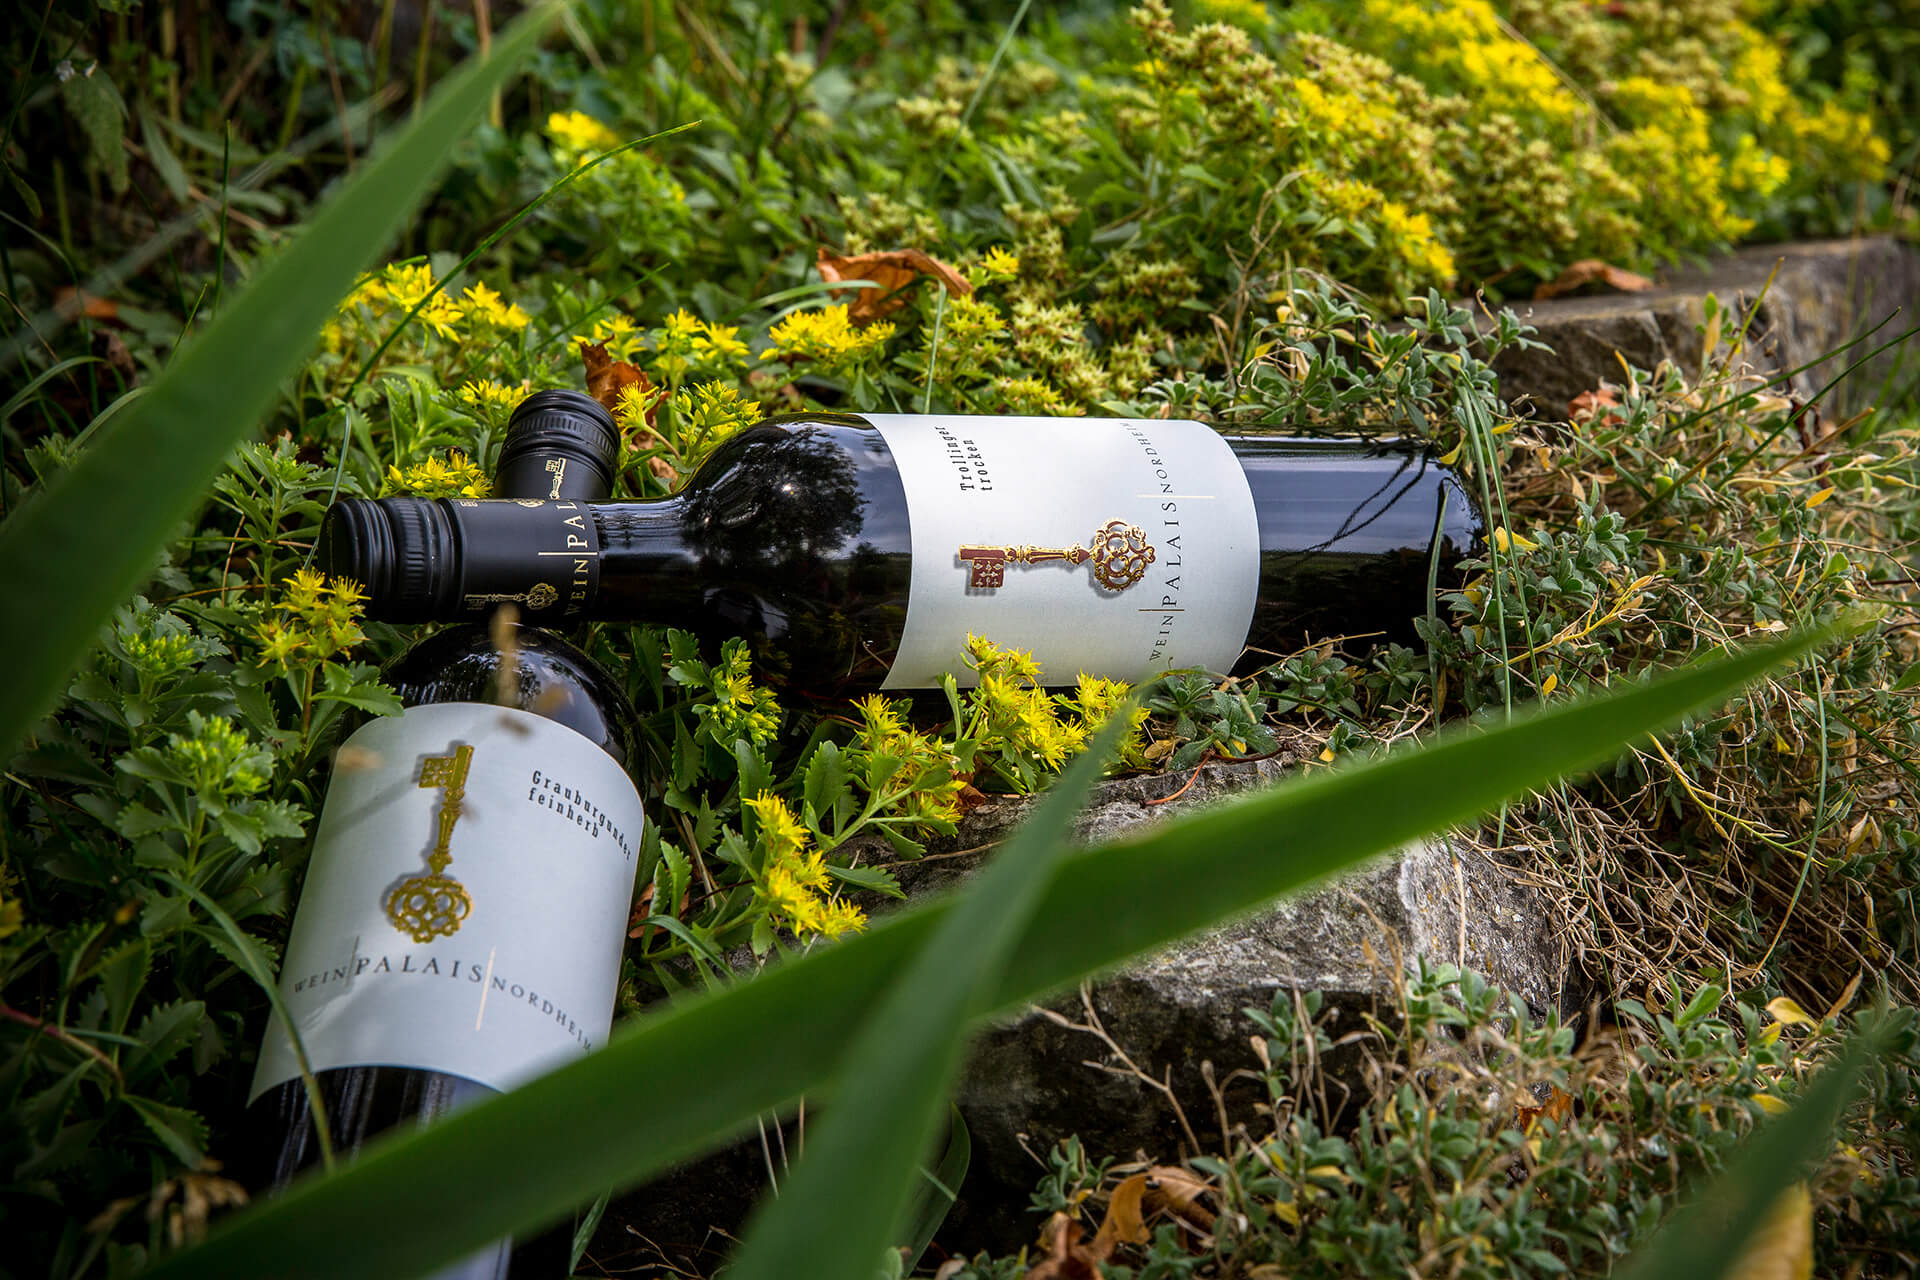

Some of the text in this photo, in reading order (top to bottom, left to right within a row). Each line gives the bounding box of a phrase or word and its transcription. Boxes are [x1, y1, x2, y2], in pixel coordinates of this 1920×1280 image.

[934, 425, 975, 491] Trollinger
[963, 439, 993, 491] trocken
[1161, 501, 1182, 608] PALAIS
[563, 558, 589, 616] WEIN
[1149, 615, 1174, 661] WEIN
[528, 787, 599, 838] feinherb
[532, 770, 631, 861] Grauburgunder
[294, 966, 349, 993] WEIN
[353, 955, 483, 984] PALAIS
